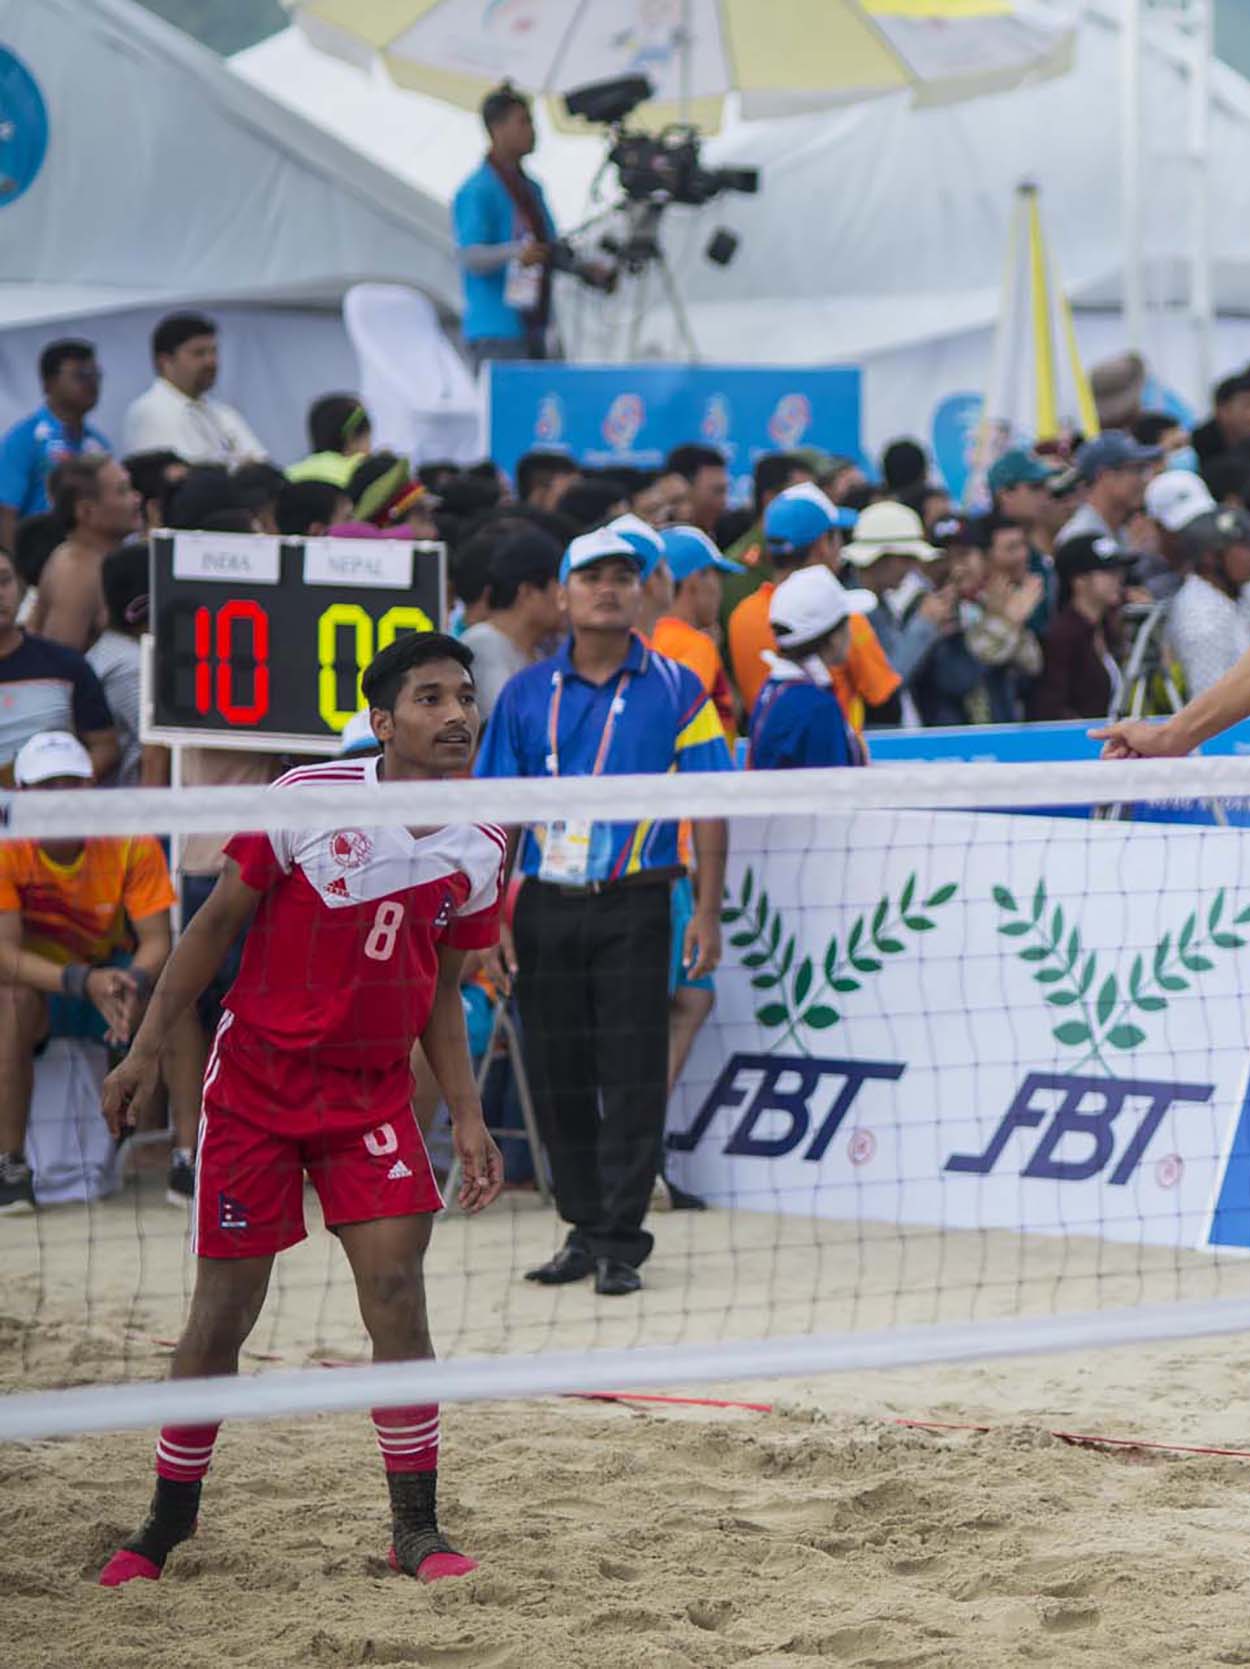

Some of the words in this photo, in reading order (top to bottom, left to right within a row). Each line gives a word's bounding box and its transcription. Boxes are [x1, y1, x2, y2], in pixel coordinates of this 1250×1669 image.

[194, 600, 269, 726] 10
[364, 900, 404, 961] 8
[666, 1053, 908, 1161] FBT
[944, 1073, 1216, 1185] FBT
